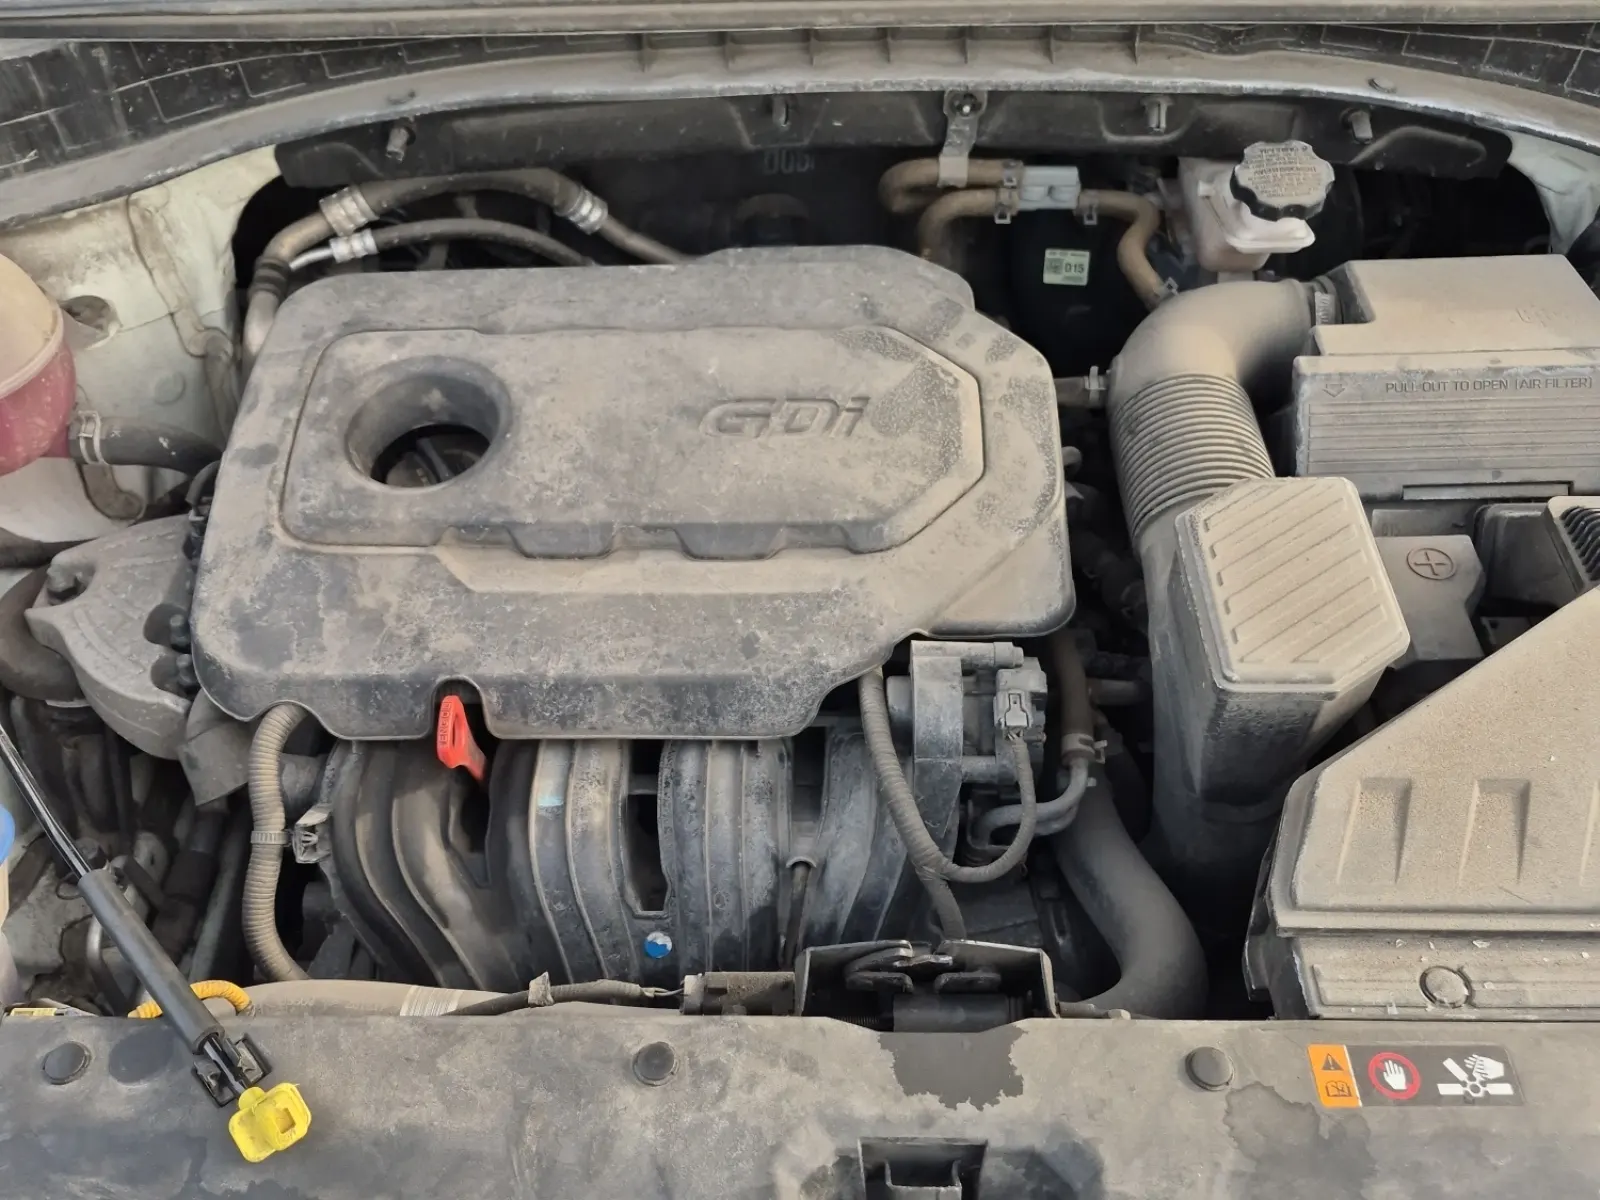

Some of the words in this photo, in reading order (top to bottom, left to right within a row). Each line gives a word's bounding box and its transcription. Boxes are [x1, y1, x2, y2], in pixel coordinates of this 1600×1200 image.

[1385, 381, 1417, 393] PULL
[1422, 380, 1449, 392] OUT
[1453, 380, 1470, 391] TO
[1473, 379, 1509, 390] OPEN
[1515, 377, 1542, 390] (AIR
[1545, 376, 1593, 389] FILTER)
[699, 396, 871, 438] GDi
